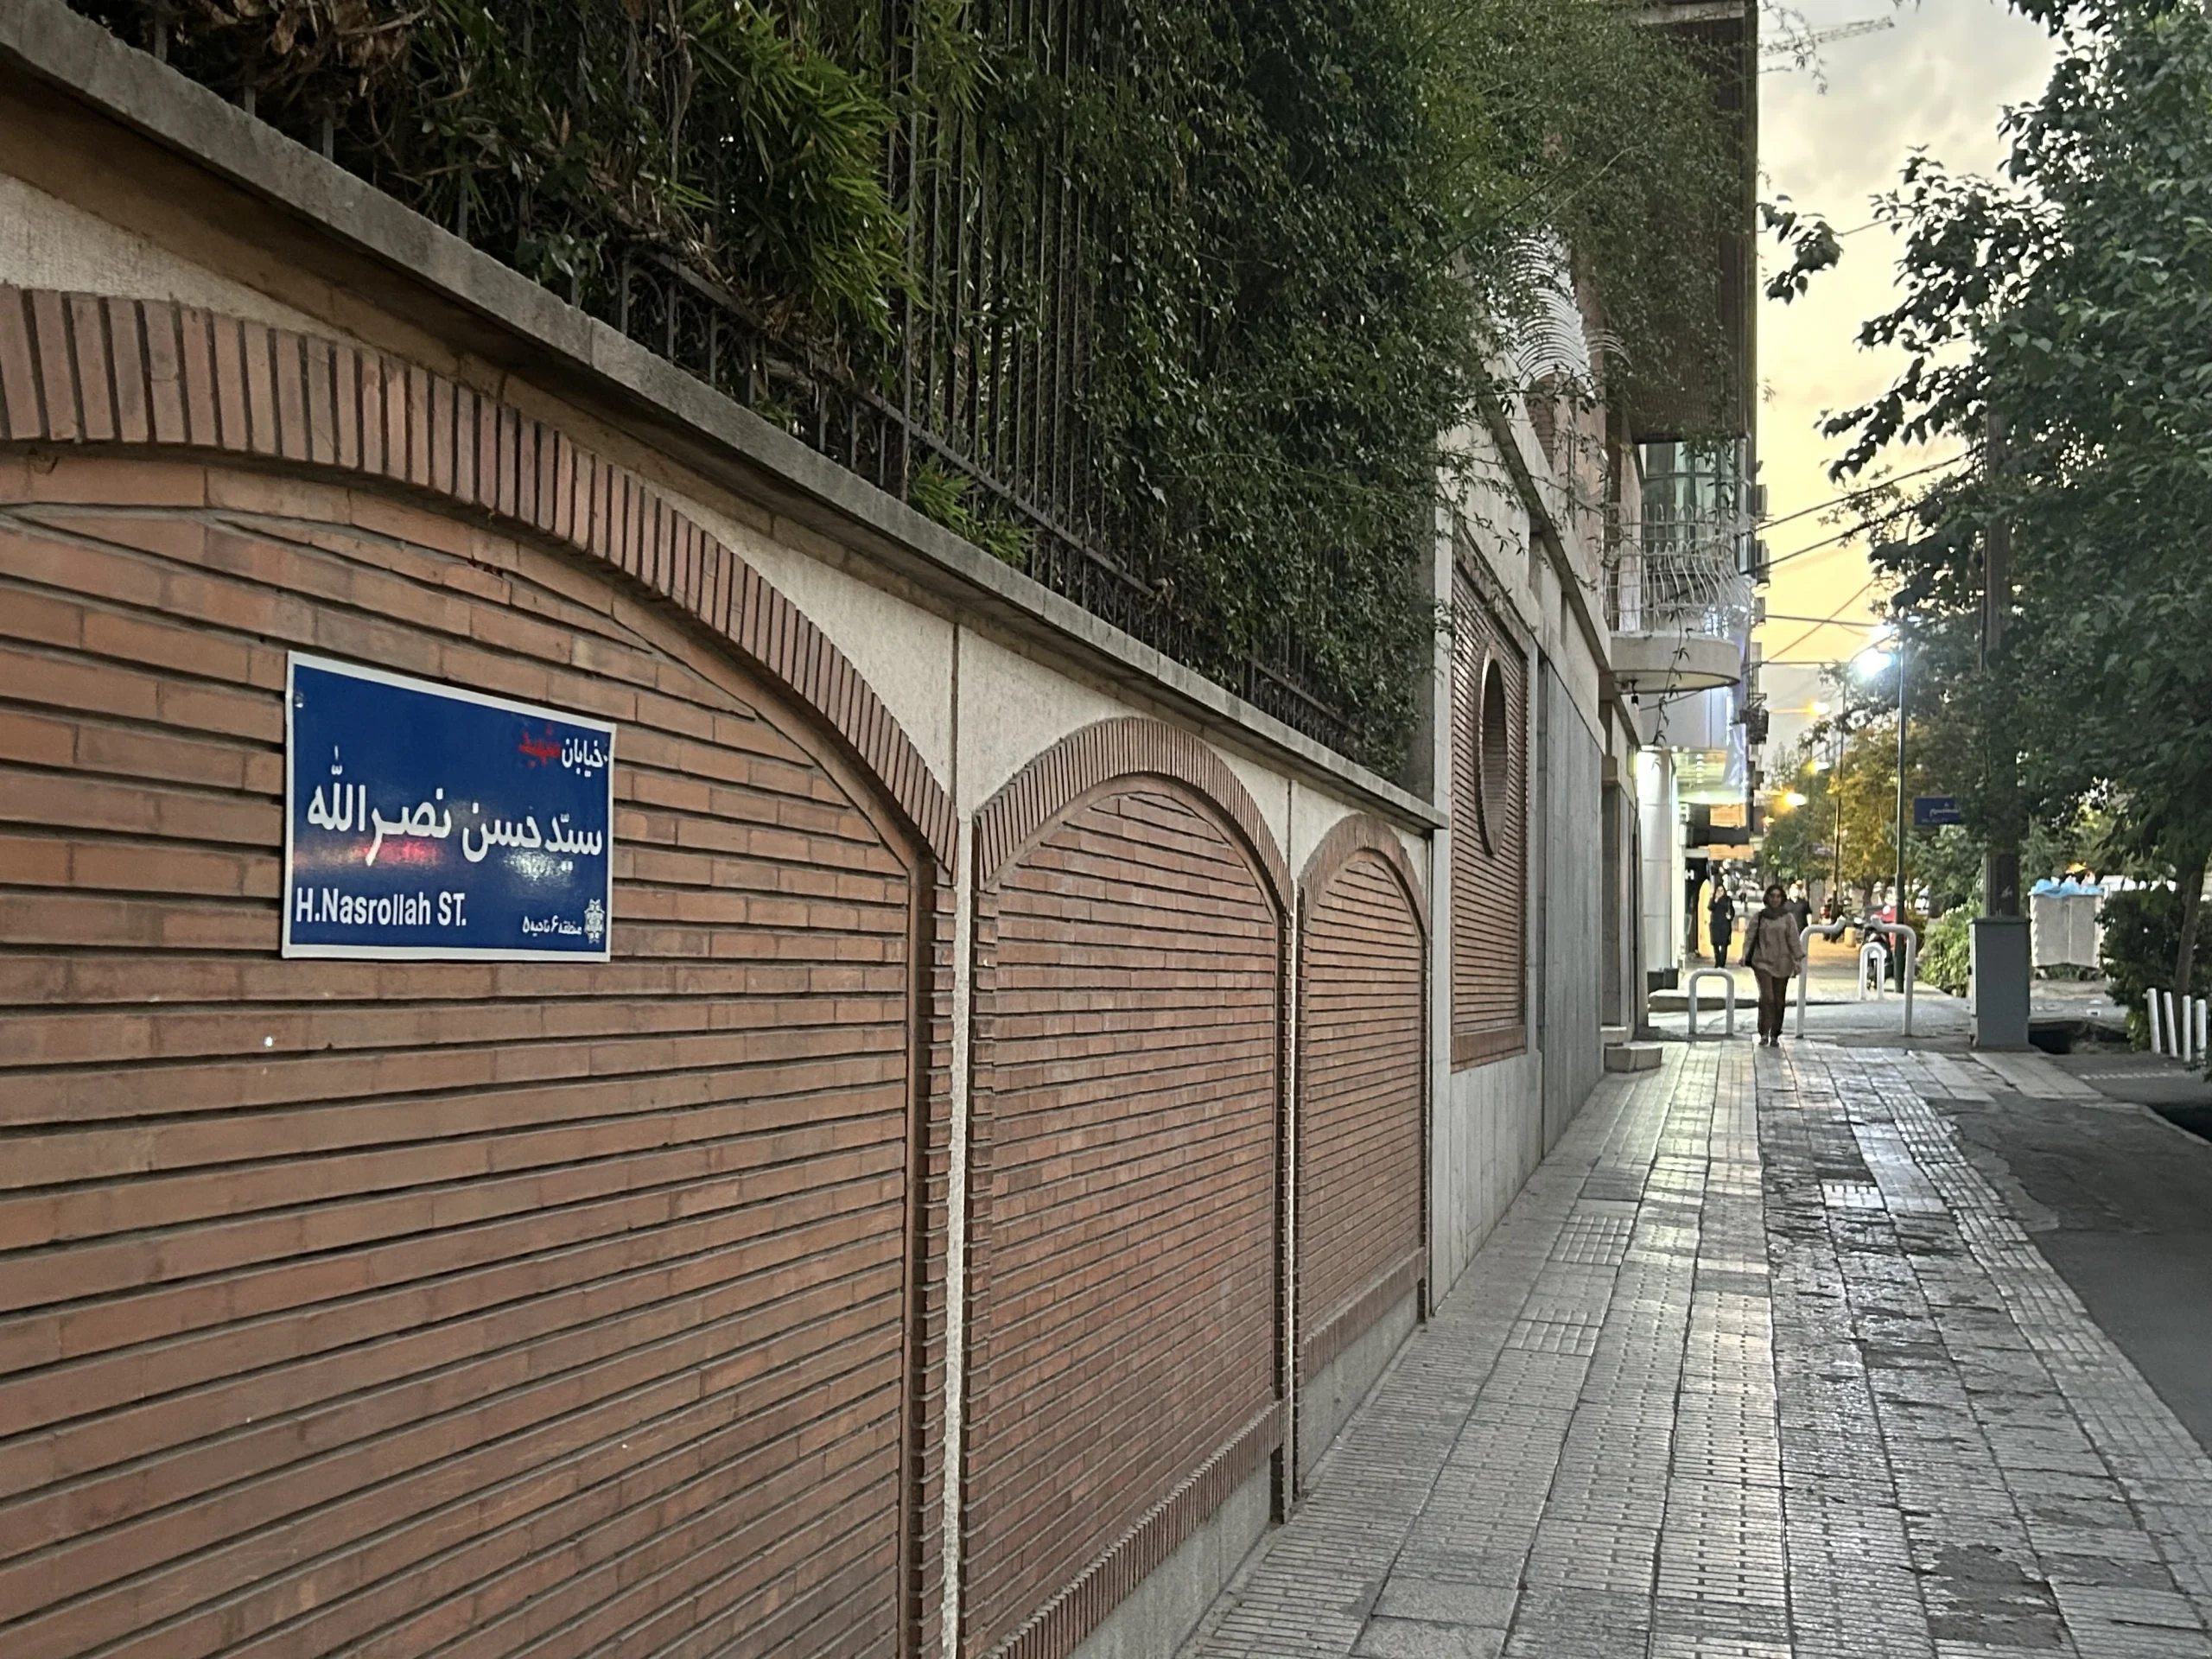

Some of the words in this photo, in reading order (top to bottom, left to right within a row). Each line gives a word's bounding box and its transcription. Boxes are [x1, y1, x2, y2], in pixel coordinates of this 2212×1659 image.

[562, 738, 604, 778] خیابان
[462, 802, 542, 862] حسن
[296, 887, 430, 925] H.Nasrollah
[437, 891, 467, 926] ST.
[531, 918, 550, 938] ناحیه
[558, 919, 582, 935] منطقه
